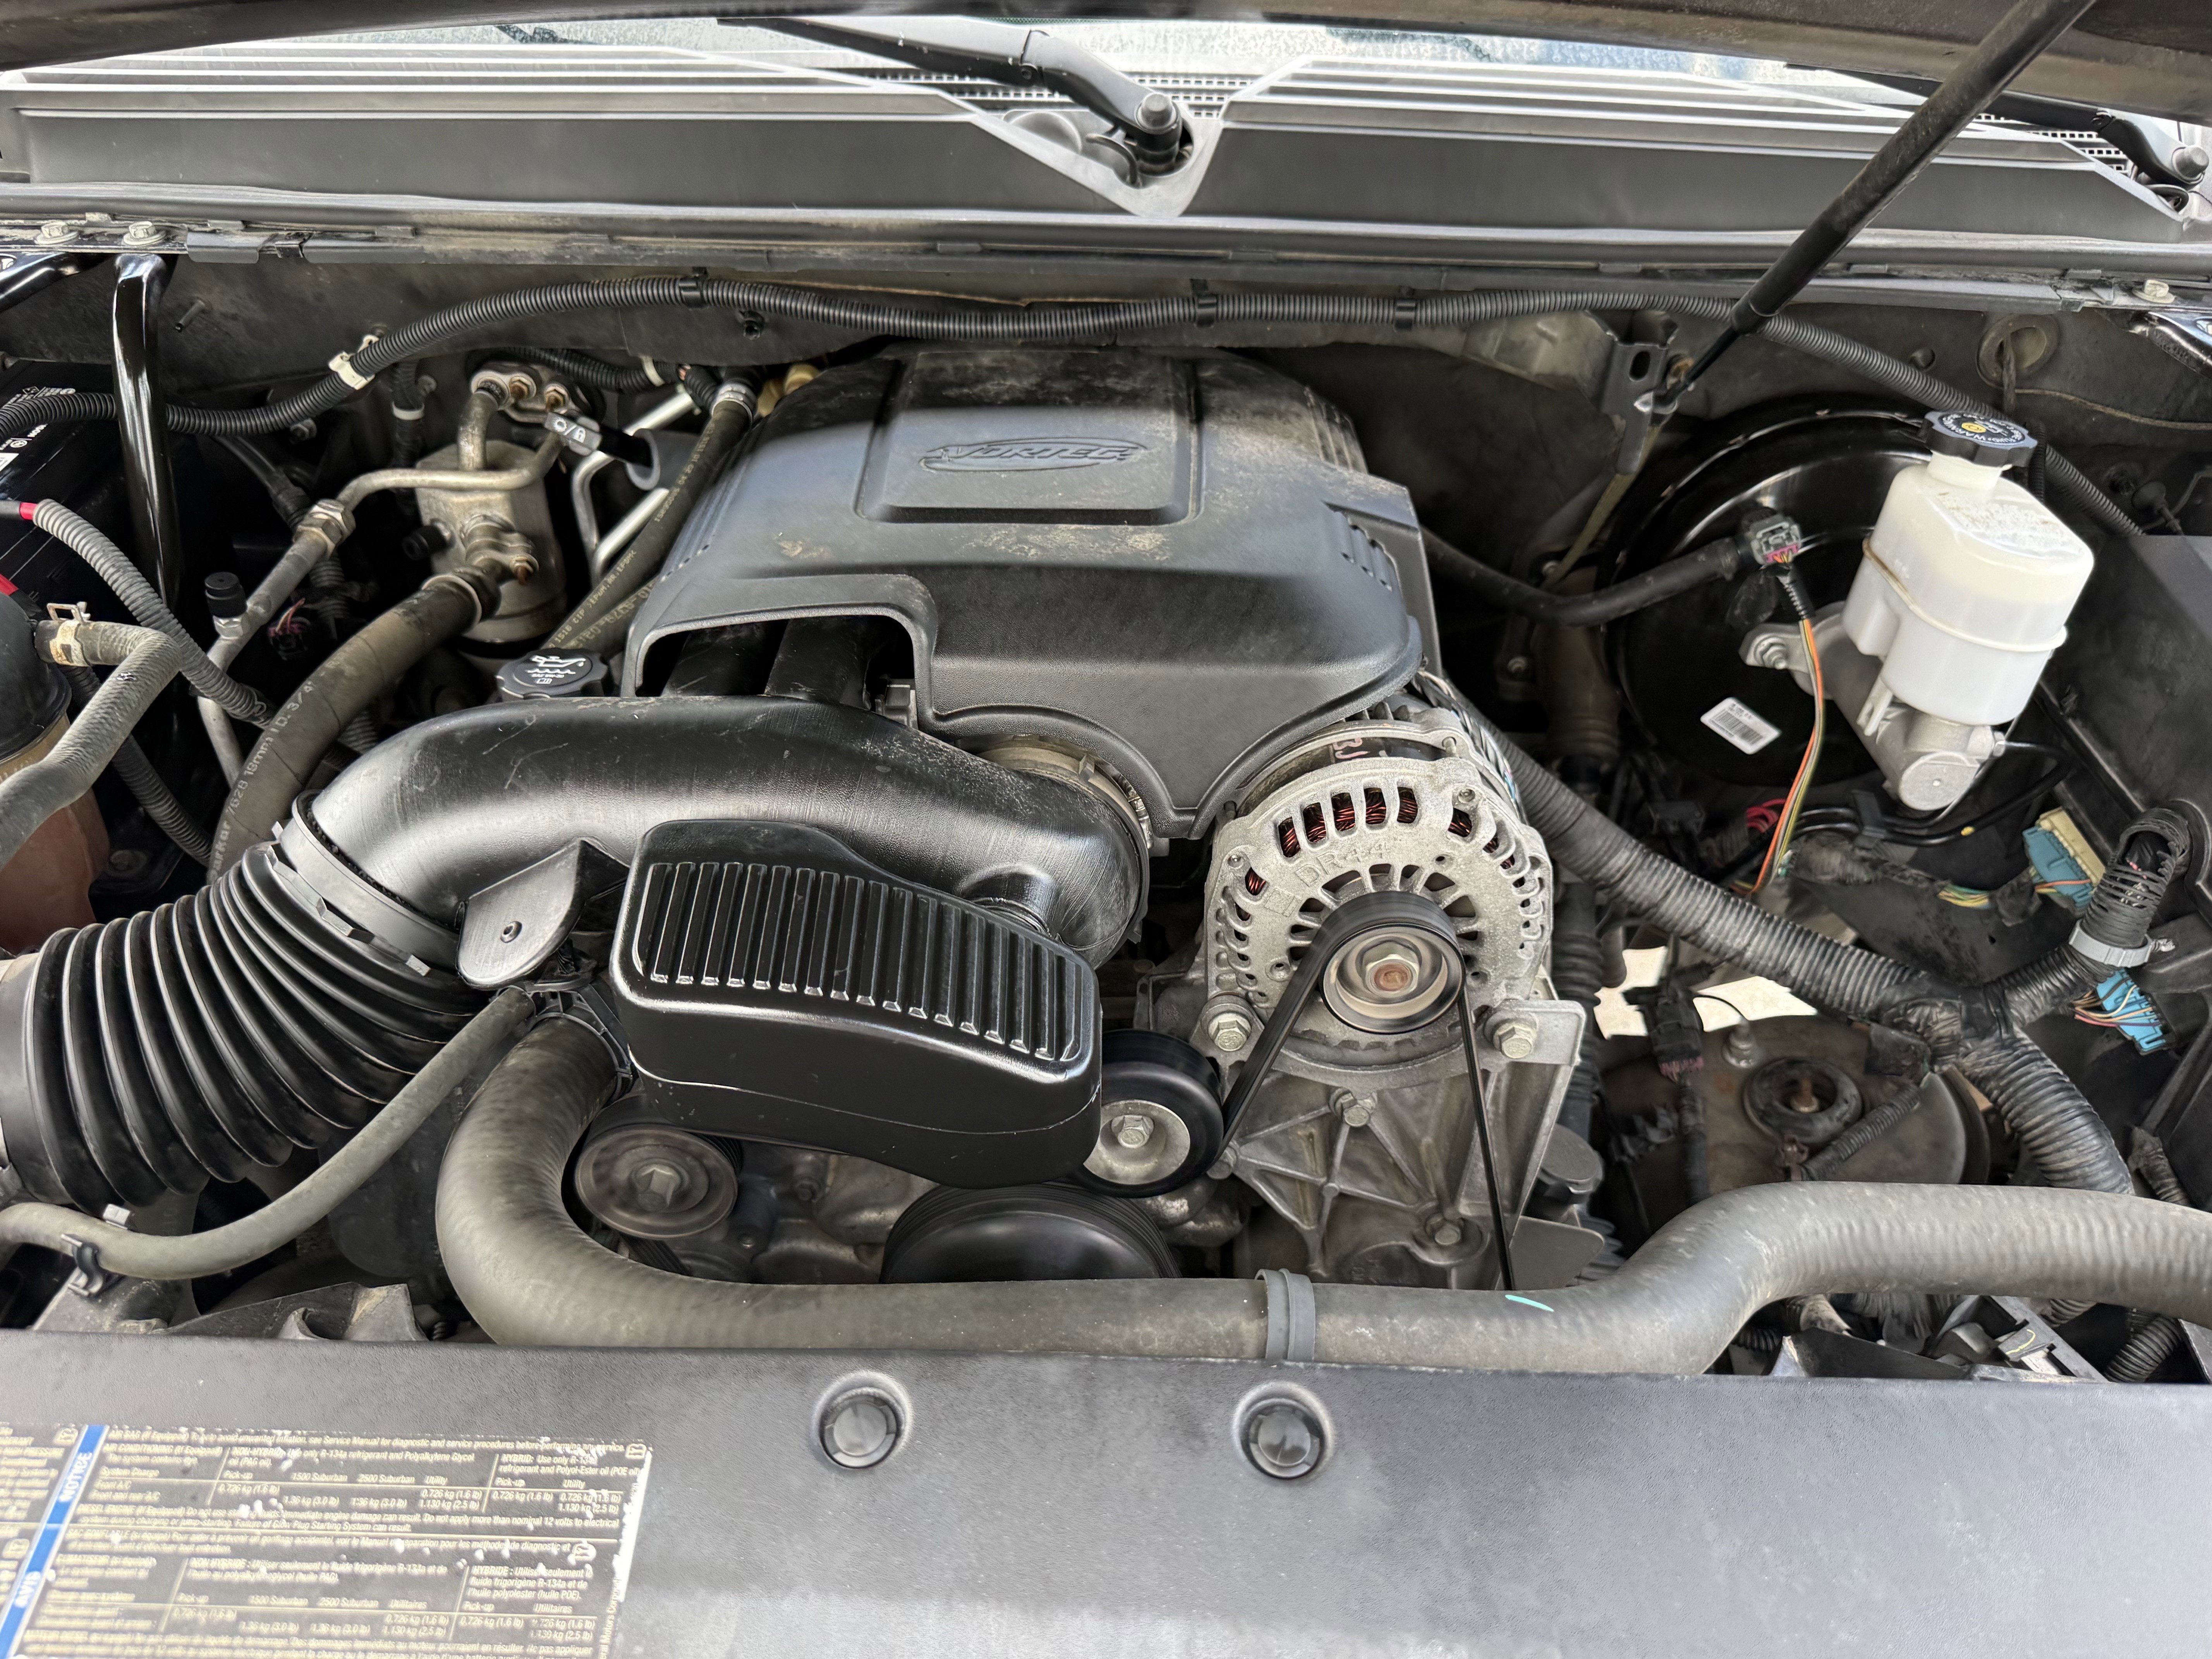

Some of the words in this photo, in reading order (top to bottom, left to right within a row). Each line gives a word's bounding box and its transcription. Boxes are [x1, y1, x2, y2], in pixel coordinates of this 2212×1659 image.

[323, 1435, 351, 1445] Service
[352, 1437, 380, 1446] Manual
[392, 1438, 430, 1448] diagnostic
[431, 1439, 445, 1448] and
[446, 1439, 473, 1448] service
[474, 1441, 514, 1451] procedures
[388, 1451, 404, 1460] and
[404, 1452, 451, 1463] Polyalkylene
[291, 1472, 311, 1481] 1500
[311, 1472, 348, 1482] Suburban
[378, 1474, 416, 1484] Suburban
[421, 1489, 445, 1498] 0.726
[445, 1491, 455, 1500] kg
[455, 1490, 471, 1499] (1.6
[472, 1491, 483, 1499] lb)
[492, 1491, 514, 1500] 0.726
[515, 1492, 526, 1502] kg
[527, 1492, 542, 1501] (1.6
[543, 1492, 554, 1501] lb)
[560, 1493, 582, 1502] 0.726
[610, 1493, 621, 1503] lb)
[380, 1498, 396, 1508] (3.0
[396, 1499, 407, 1508] lb)
[418, 1499, 440, 1508] 1.130
[441, 1500, 452, 1510] kg
[453, 1500, 468, 1509] (2.5
[469, 1500, 480, 1509] lb)
[558, 1503, 580, 1512] 1.130
[608, 1504, 619, 1513] lb)
[350, 1512, 381, 1522] damage
[422, 1513, 434, 1522] Do
[449, 1515, 471, 1526] apply
[471, 1516, 492, 1525] more
[493, 1516, 510, 1524] than
[543, 1517, 555, 1525] 12
[555, 1518, 574, 1526] volts
[311, 1521, 341, 1531] Starting
[342, 1522, 371, 1532] System
[471, 1565, 509, 1575] HYBRIDE
[537, 1578, 566, 1587] R-134a
[496, 1617, 512, 1626] (1.6
[513, 1617, 524, 1627] lb)
[565, 1630, 581, 1640] (2.5
